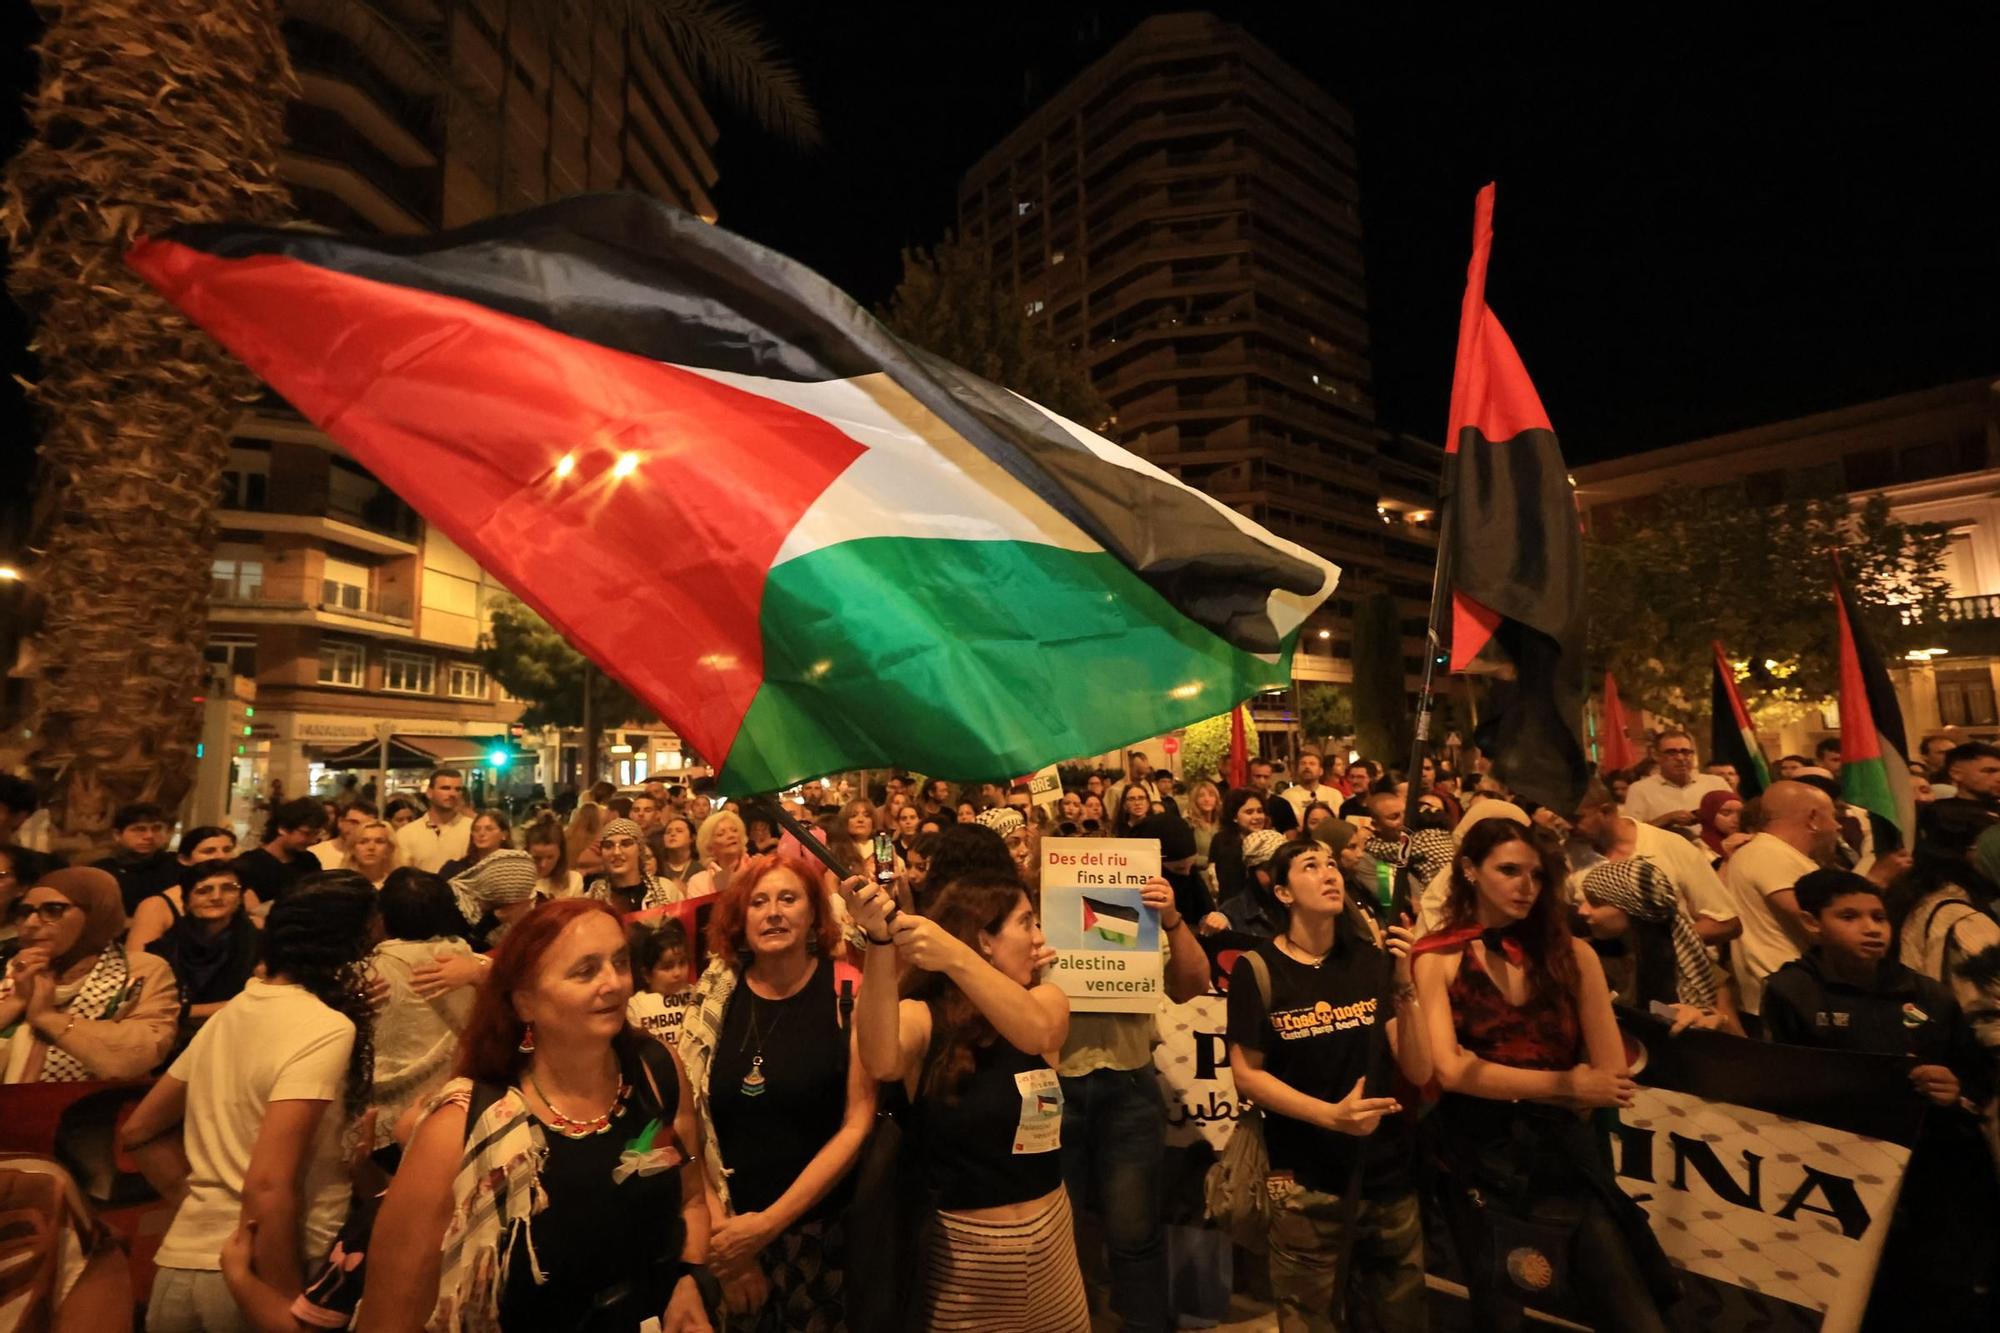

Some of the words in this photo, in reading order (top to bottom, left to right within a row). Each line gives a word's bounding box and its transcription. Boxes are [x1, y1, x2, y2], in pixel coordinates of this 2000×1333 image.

[1029, 776, 1052, 794] BRE
[1049, 852, 1077, 866] Des
[1080, 852, 1104, 866] del
[1107, 853, 1128, 867] riu
[1077, 870, 1105, 885] fins
[1108, 871, 1122, 885] al
[1086, 977, 1156, 993] vencerà!
[1612, 1122, 1872, 1241] INA
